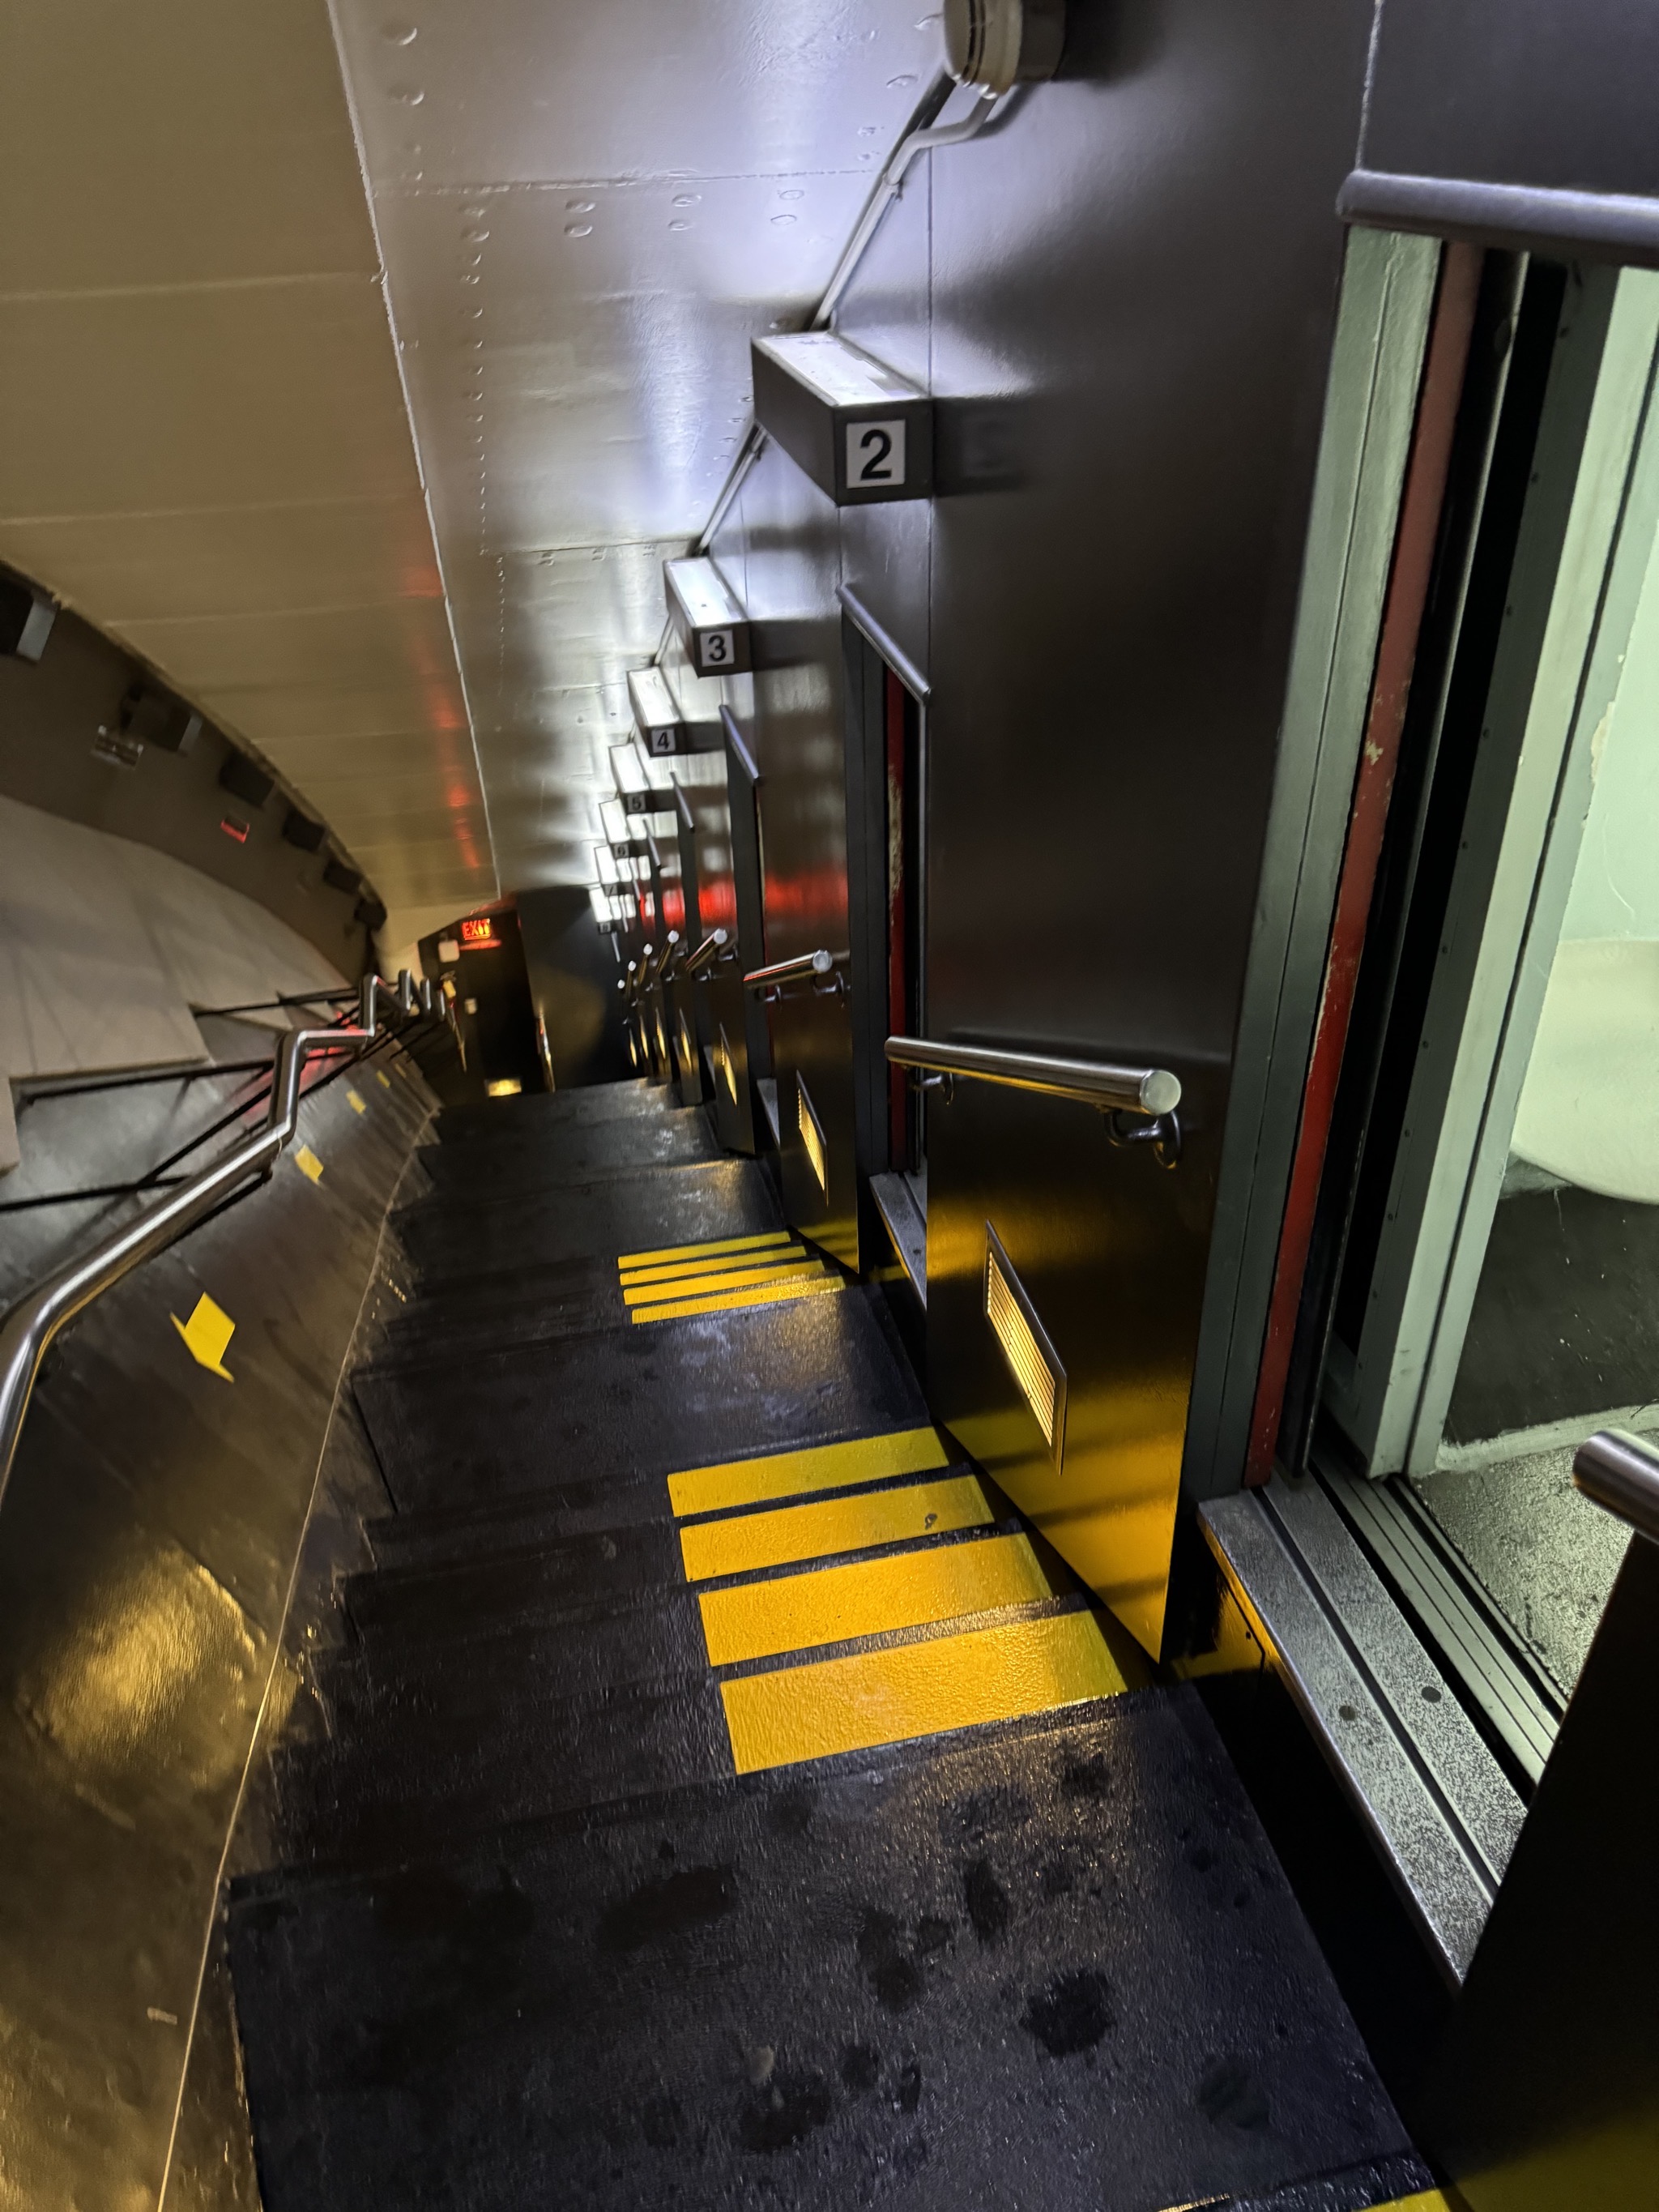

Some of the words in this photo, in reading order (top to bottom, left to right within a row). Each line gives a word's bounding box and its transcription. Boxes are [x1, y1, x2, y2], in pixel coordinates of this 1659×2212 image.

[860, 429, 892, 480] 2
[708, 634, 727, 663] 3
[657, 732, 670, 750] 4
[462, 918, 490, 937] EXIT
